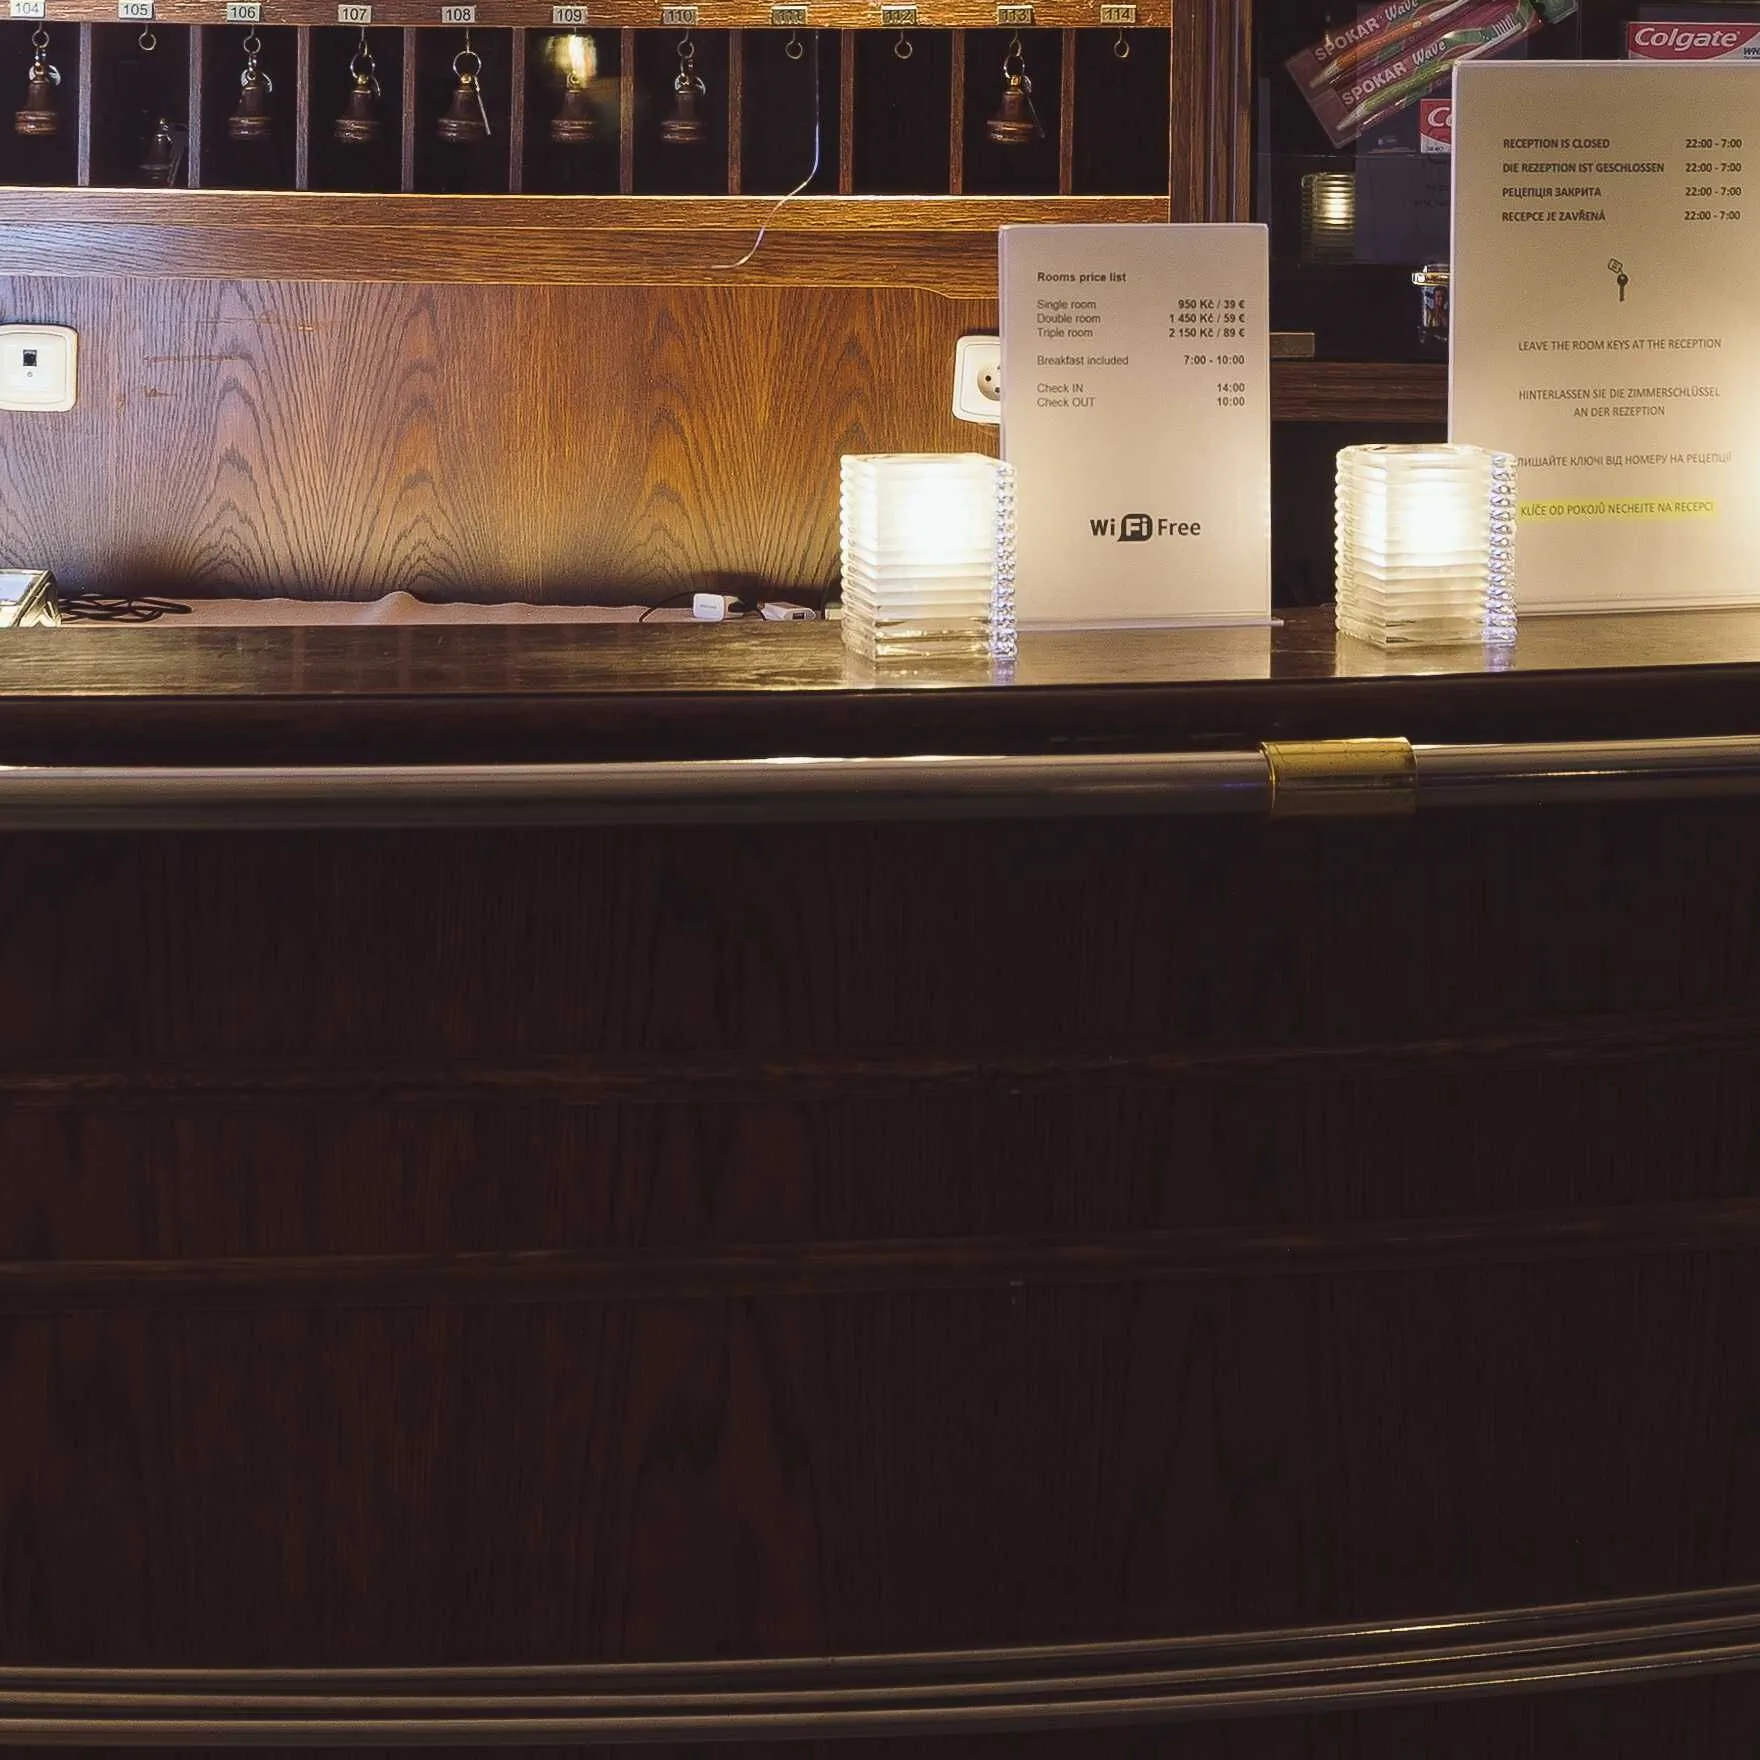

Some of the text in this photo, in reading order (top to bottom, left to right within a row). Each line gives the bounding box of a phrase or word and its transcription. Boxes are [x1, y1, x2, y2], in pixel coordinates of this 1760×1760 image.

[15, 1, 40, 14] 104
[123, 3, 148, 16] 105
[231, 5, 256, 19] 106
[342, 7, 368, 21] 107
[1106, 7, 1131, 20] 114
[446, 8, 471, 22] 108
[557, 9, 582, 22] 109
[668, 10, 693, 23] 110
[885, 9, 911, 22] 112
[1001, 8, 1027, 21] 113
[1314, 17, 1380, 62] SPOKAR
[1635, 27, 1738, 52] Colgate
[1341, 38, 1446, 106] SPOKAR Wave
[1503, 139, 1742, 149] RECEPTION IS CLOSED 22:00 7:00
[1503, 163, 1741, 173] DIE REZEPTION IST GESCHLOSSEN 22:00 7:00
[1503, 187, 1741, 199] РЕЦЕПЦІЯ ЗАКРИТА 22:00 7:00
[1502, 209, 1740, 222] RECEPCE JE ZAVŘENÁ 22:00 7:00
[1037, 272, 1127, 284] Rooms price list
[1037, 300, 1068, 311] Single
[1178, 300, 1196, 309] 950
[1200, 299, 1214, 309] Kč
[1224, 300, 1236, 309] 39
[1239, 300, 1245, 309] €
[1037, 314, 1072, 324] Double
[1178, 314, 1196, 323] 450
[1200, 314, 1214, 323] Kč
[1224, 314, 1236, 323] 59
[1239, 314, 1245, 323] €
[1037, 327, 1245, 339] Triple room 2 150 Kč 89 €
[1519, 339, 1721, 352] LEAVE THE ROOM KEYS AT THE RECEPTION
[1037, 355, 1244, 366] Breakfast included 7:00 10:00
[1037, 383, 1245, 393] Check IN 14:00
[1519, 386, 1720, 400] HINTERLASSEN SIE DIE ZIMMERSCHLÜSSEL
[1037, 397, 1245, 407] Check OUT 10:00
[1574, 406, 1665, 417] AN DER REZEPTION
[1625, 454, 1668, 465] НОМЕРУ
[1670, 454, 1684, 465] НА
[1521, 502, 1713, 516] KLÍČE OD POKOJŮ NECHEJTE NA RECEPCI
[1158, 518, 1201, 536] Free
